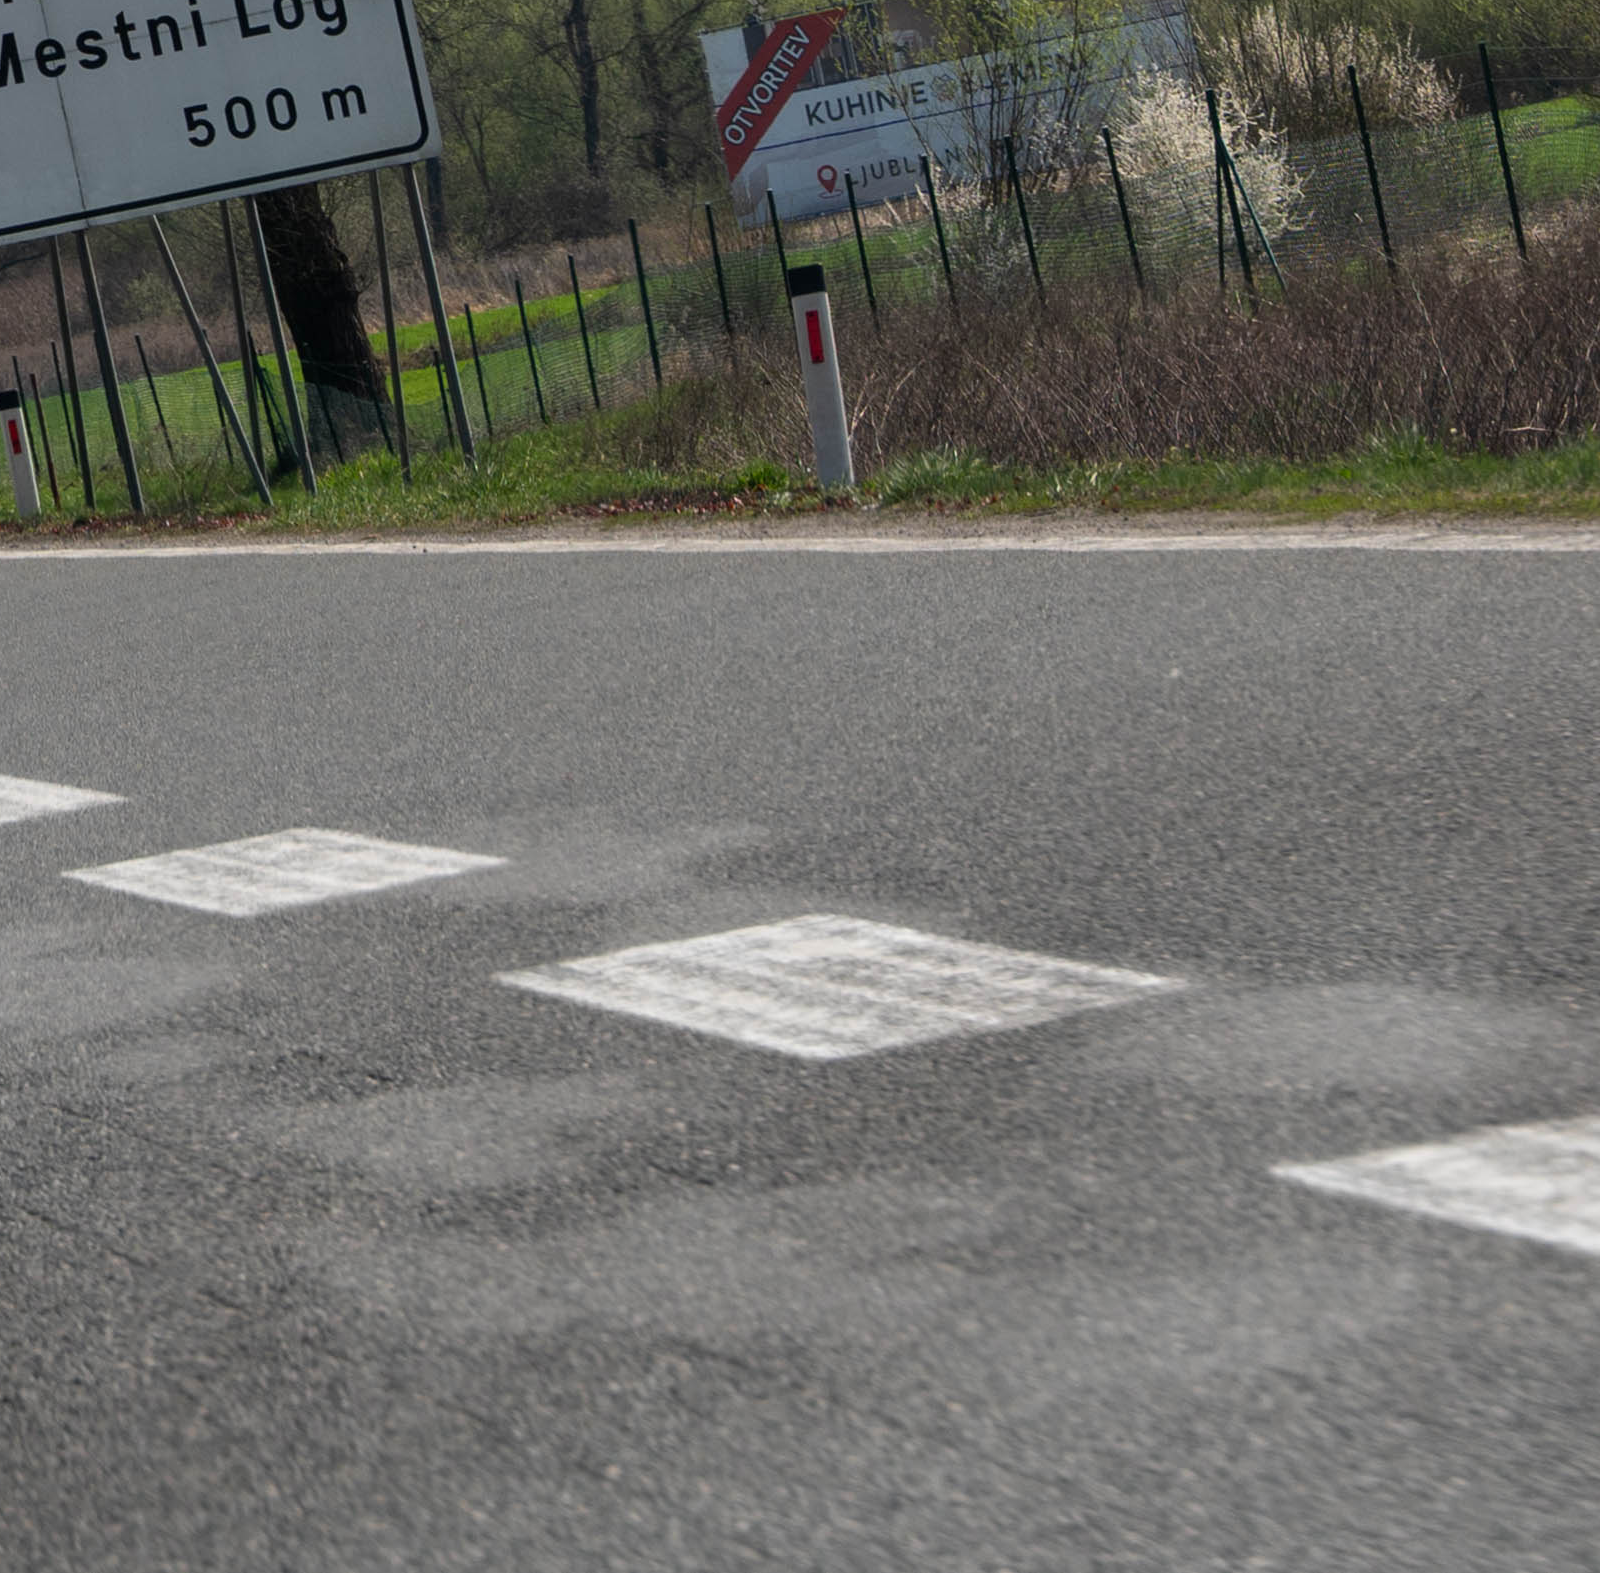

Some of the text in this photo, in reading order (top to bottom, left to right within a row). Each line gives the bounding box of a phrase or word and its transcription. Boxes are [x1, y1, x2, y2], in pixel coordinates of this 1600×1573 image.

[183, 83, 368, 149] 500 m
[723, 24, 811, 146] OTVORITEV
